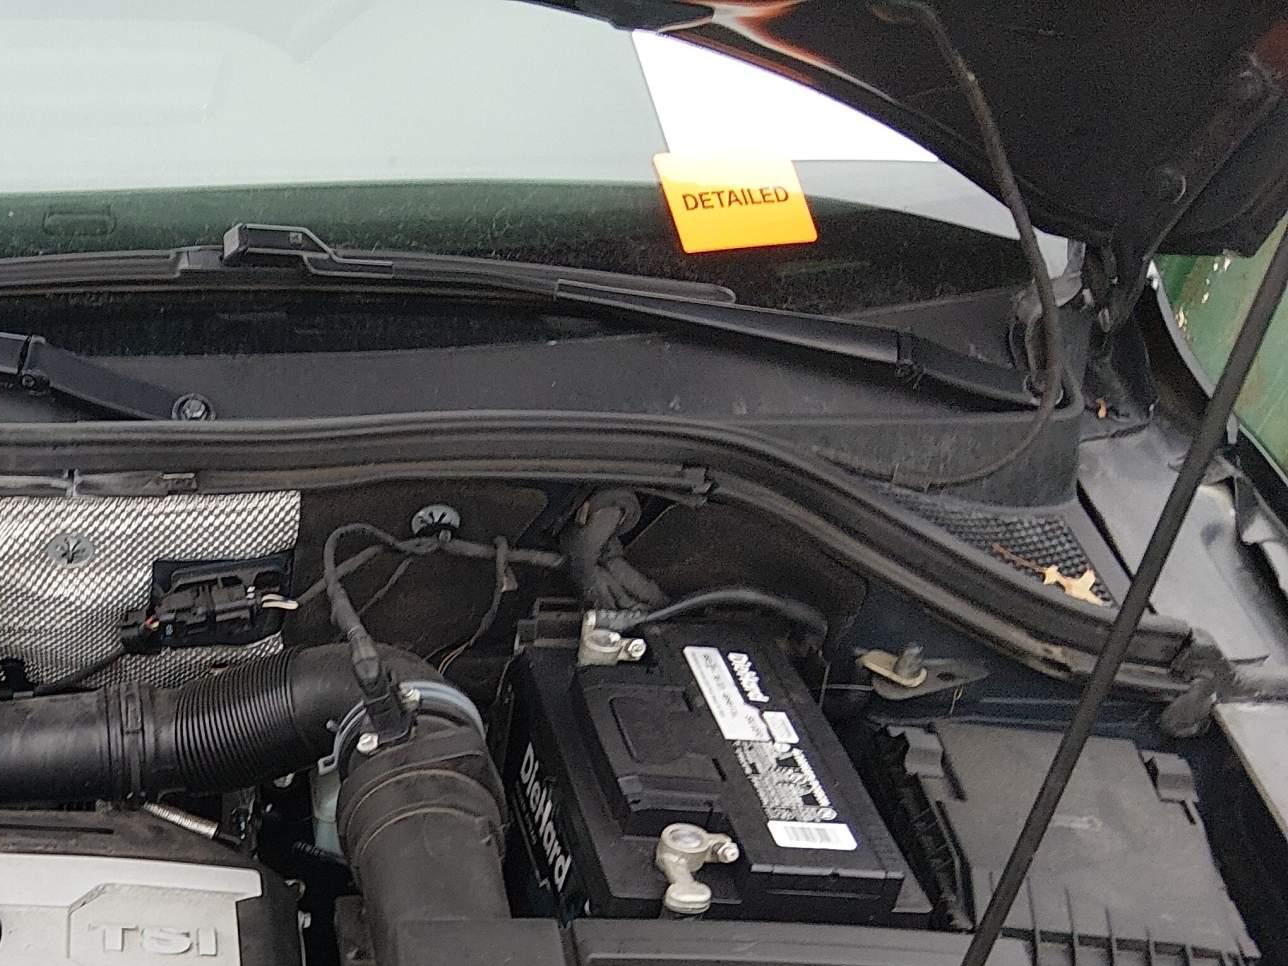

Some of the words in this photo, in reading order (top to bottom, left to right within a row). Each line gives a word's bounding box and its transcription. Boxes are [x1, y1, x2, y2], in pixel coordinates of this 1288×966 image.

[682, 186, 789, 211] DETAILED
[520, 741, 571, 893] DieHard
[88, 925, 218, 956] TSI
